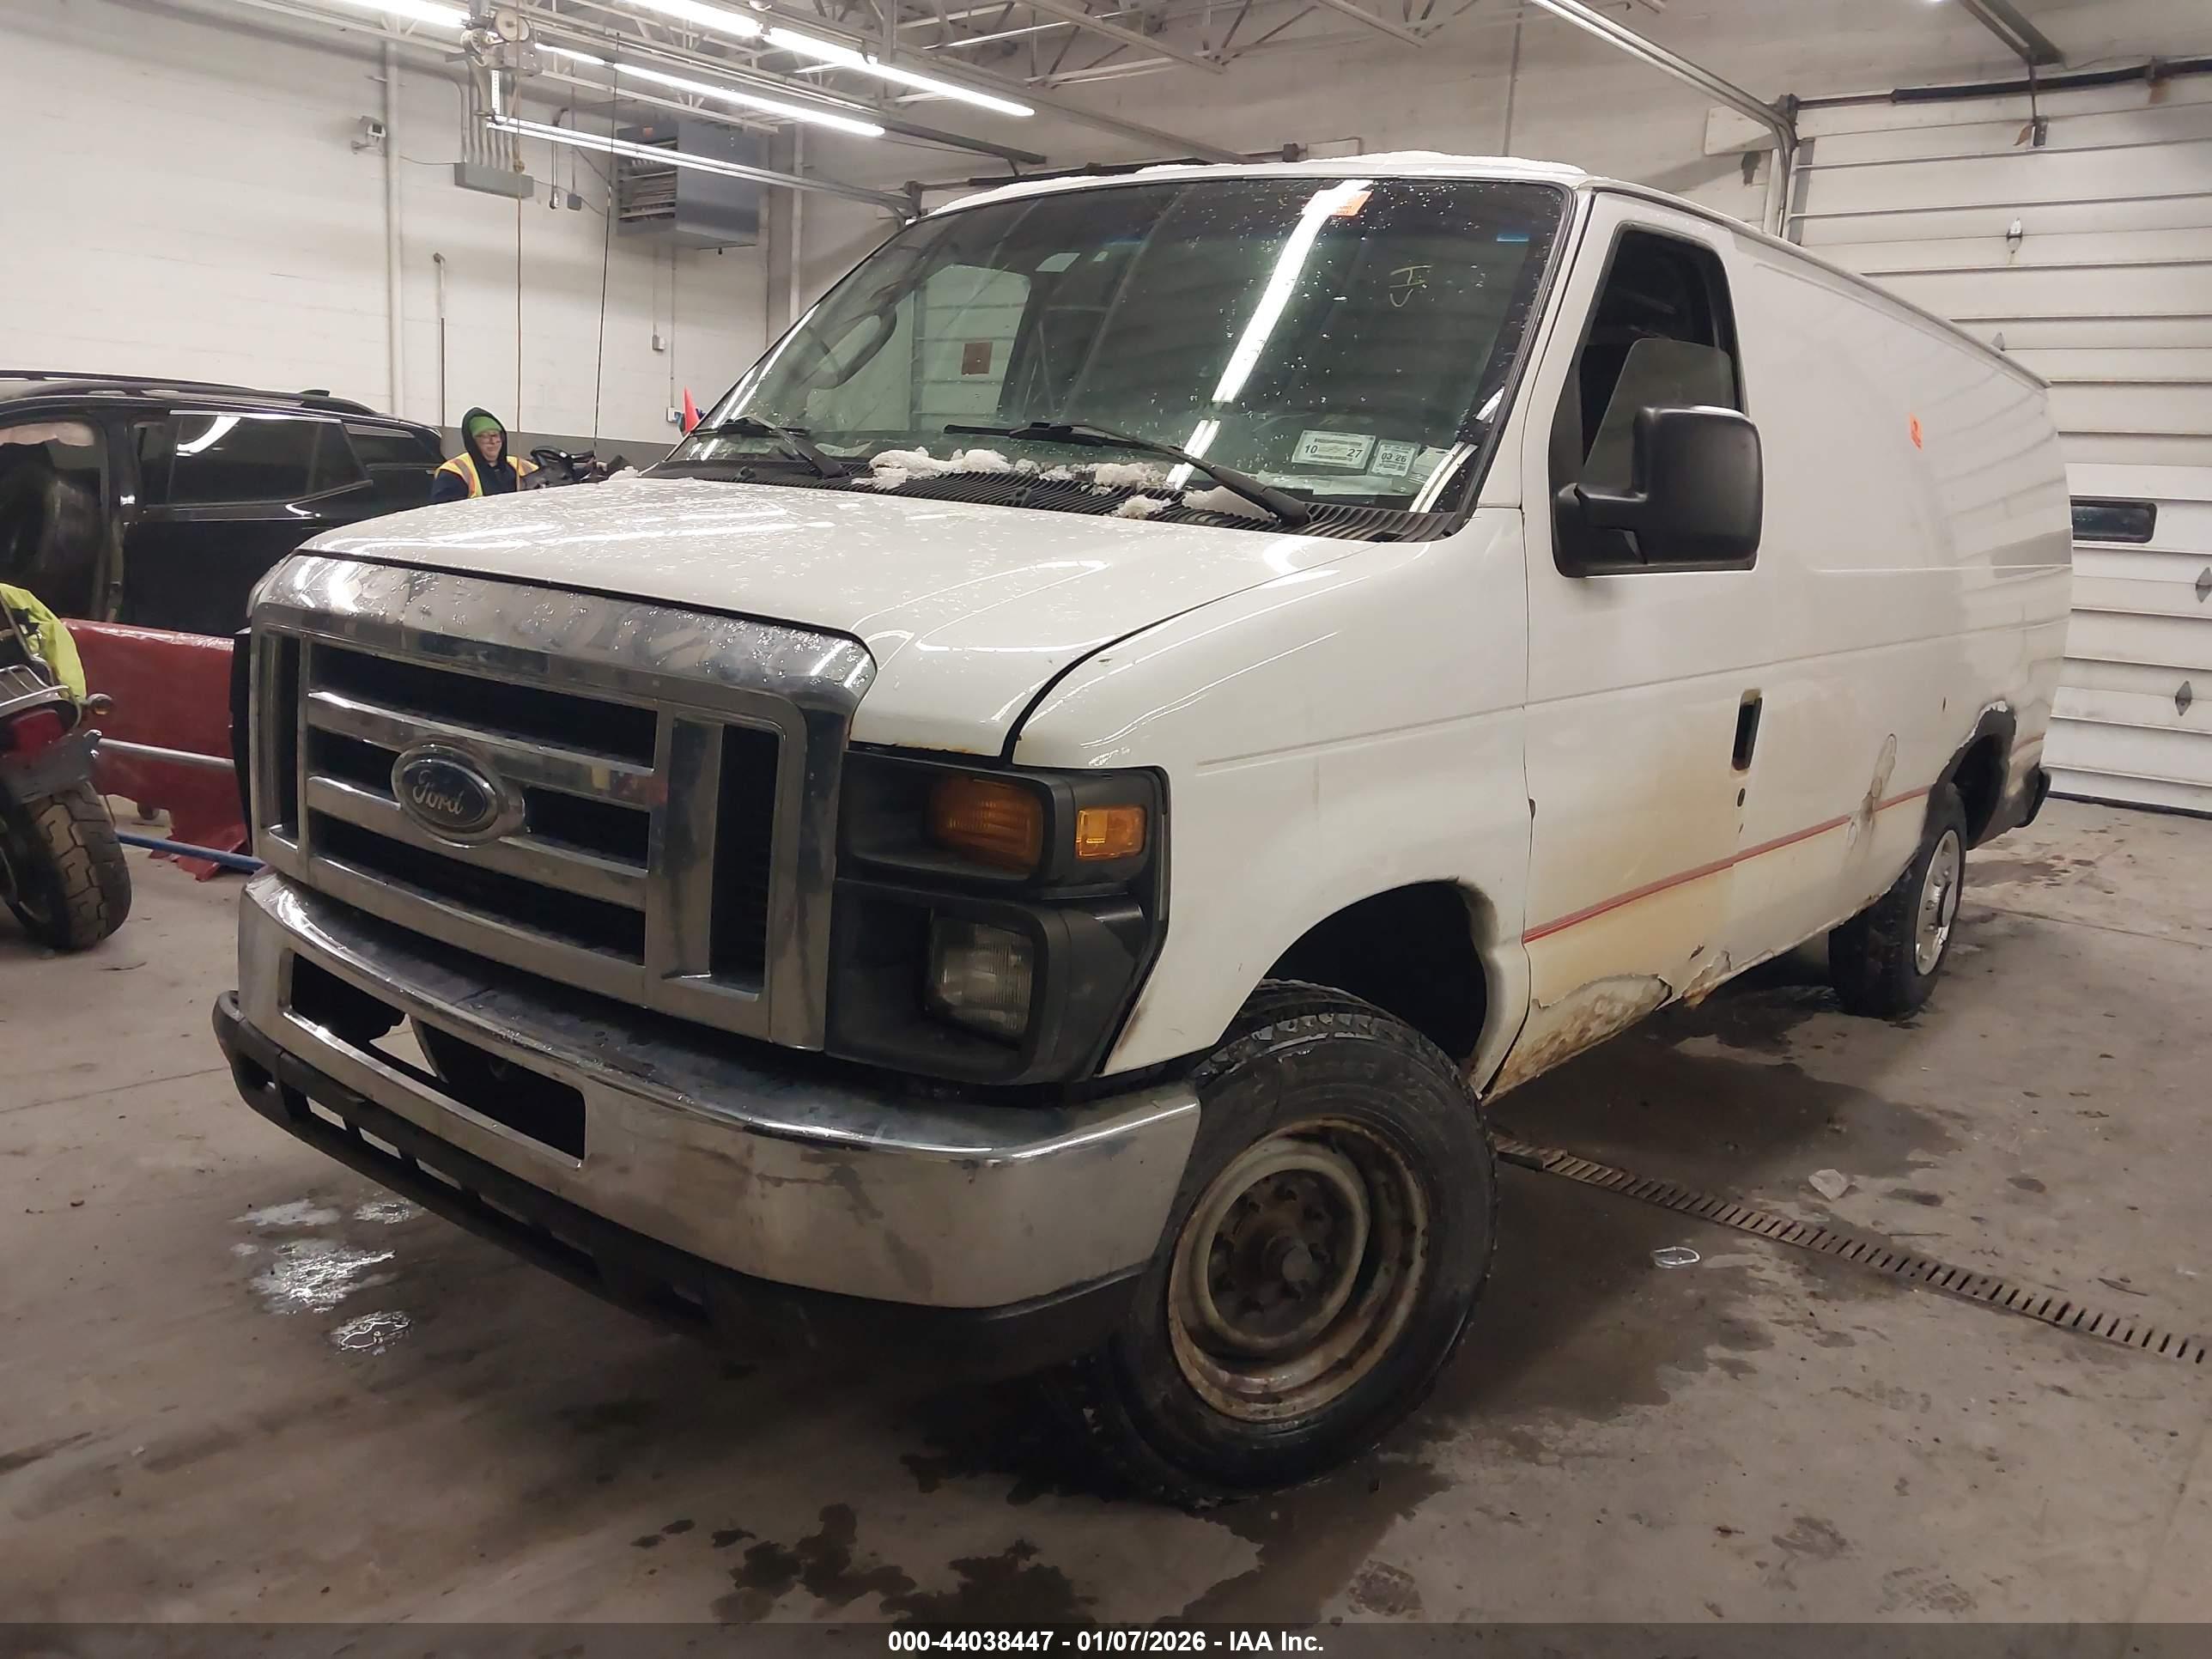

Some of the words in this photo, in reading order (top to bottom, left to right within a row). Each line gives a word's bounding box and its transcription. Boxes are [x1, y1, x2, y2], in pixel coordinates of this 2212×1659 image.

[1304, 445, 1318, 454] 10
[1346, 448, 1364, 458] 27
[1395, 453, 1407, 463] 26
[412, 769, 465, 815] Ford
